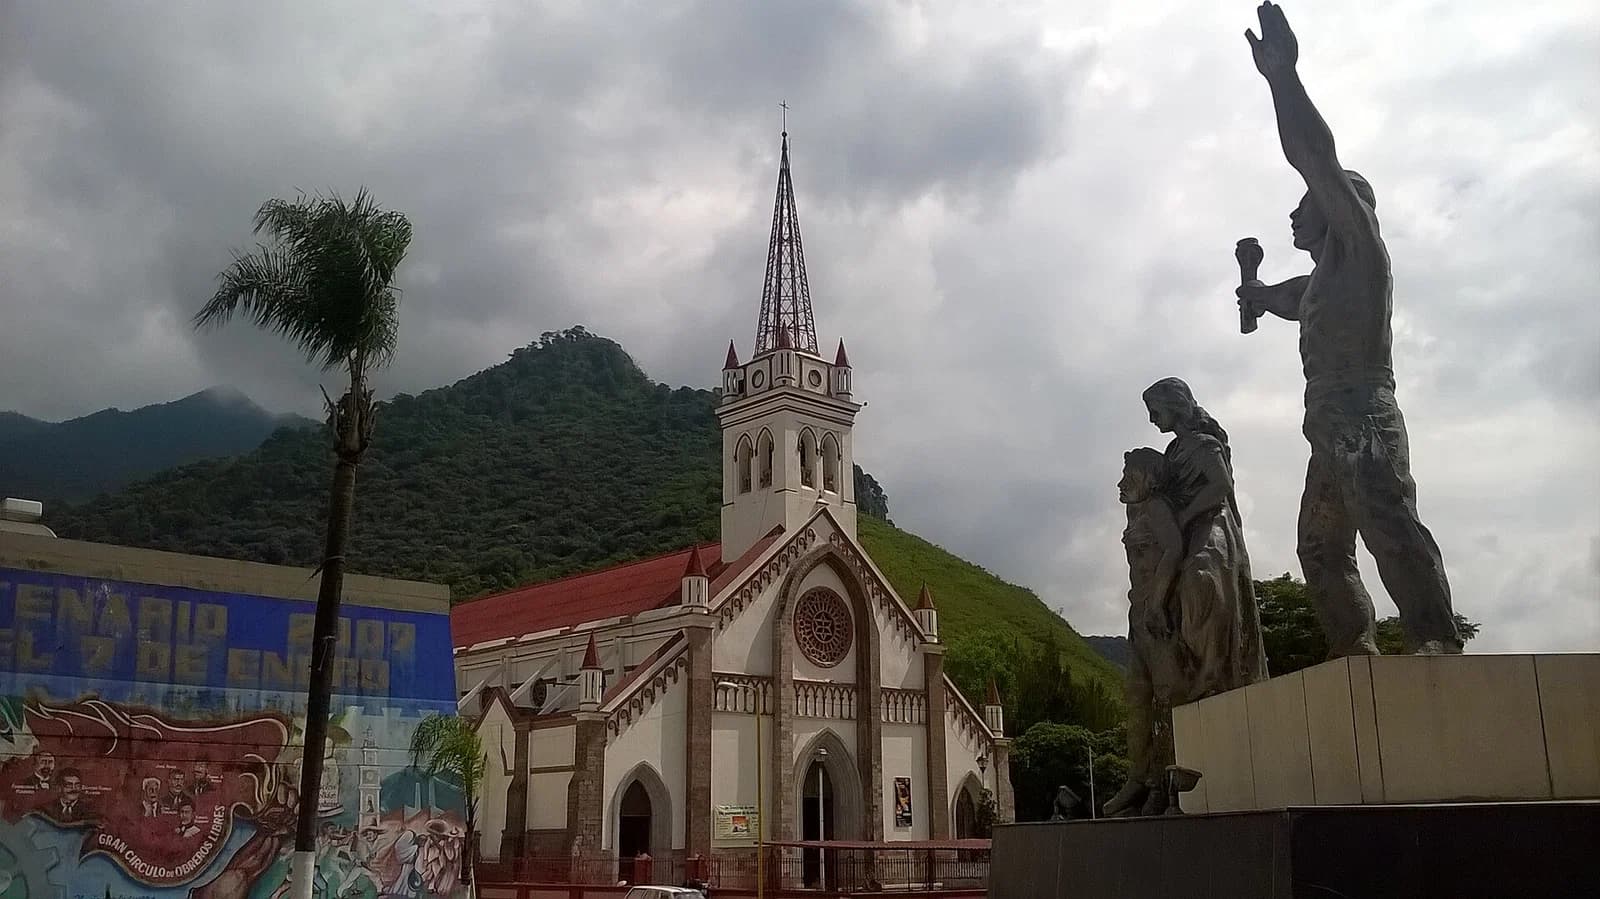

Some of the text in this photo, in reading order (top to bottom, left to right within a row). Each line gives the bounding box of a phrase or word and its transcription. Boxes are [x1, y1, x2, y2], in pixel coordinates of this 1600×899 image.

[98, 833, 129, 854] GRAN
[124, 850, 166, 878] CIRCULO
[175, 842, 213, 877] OBREROS
[208, 804, 226, 843] LIBRES
